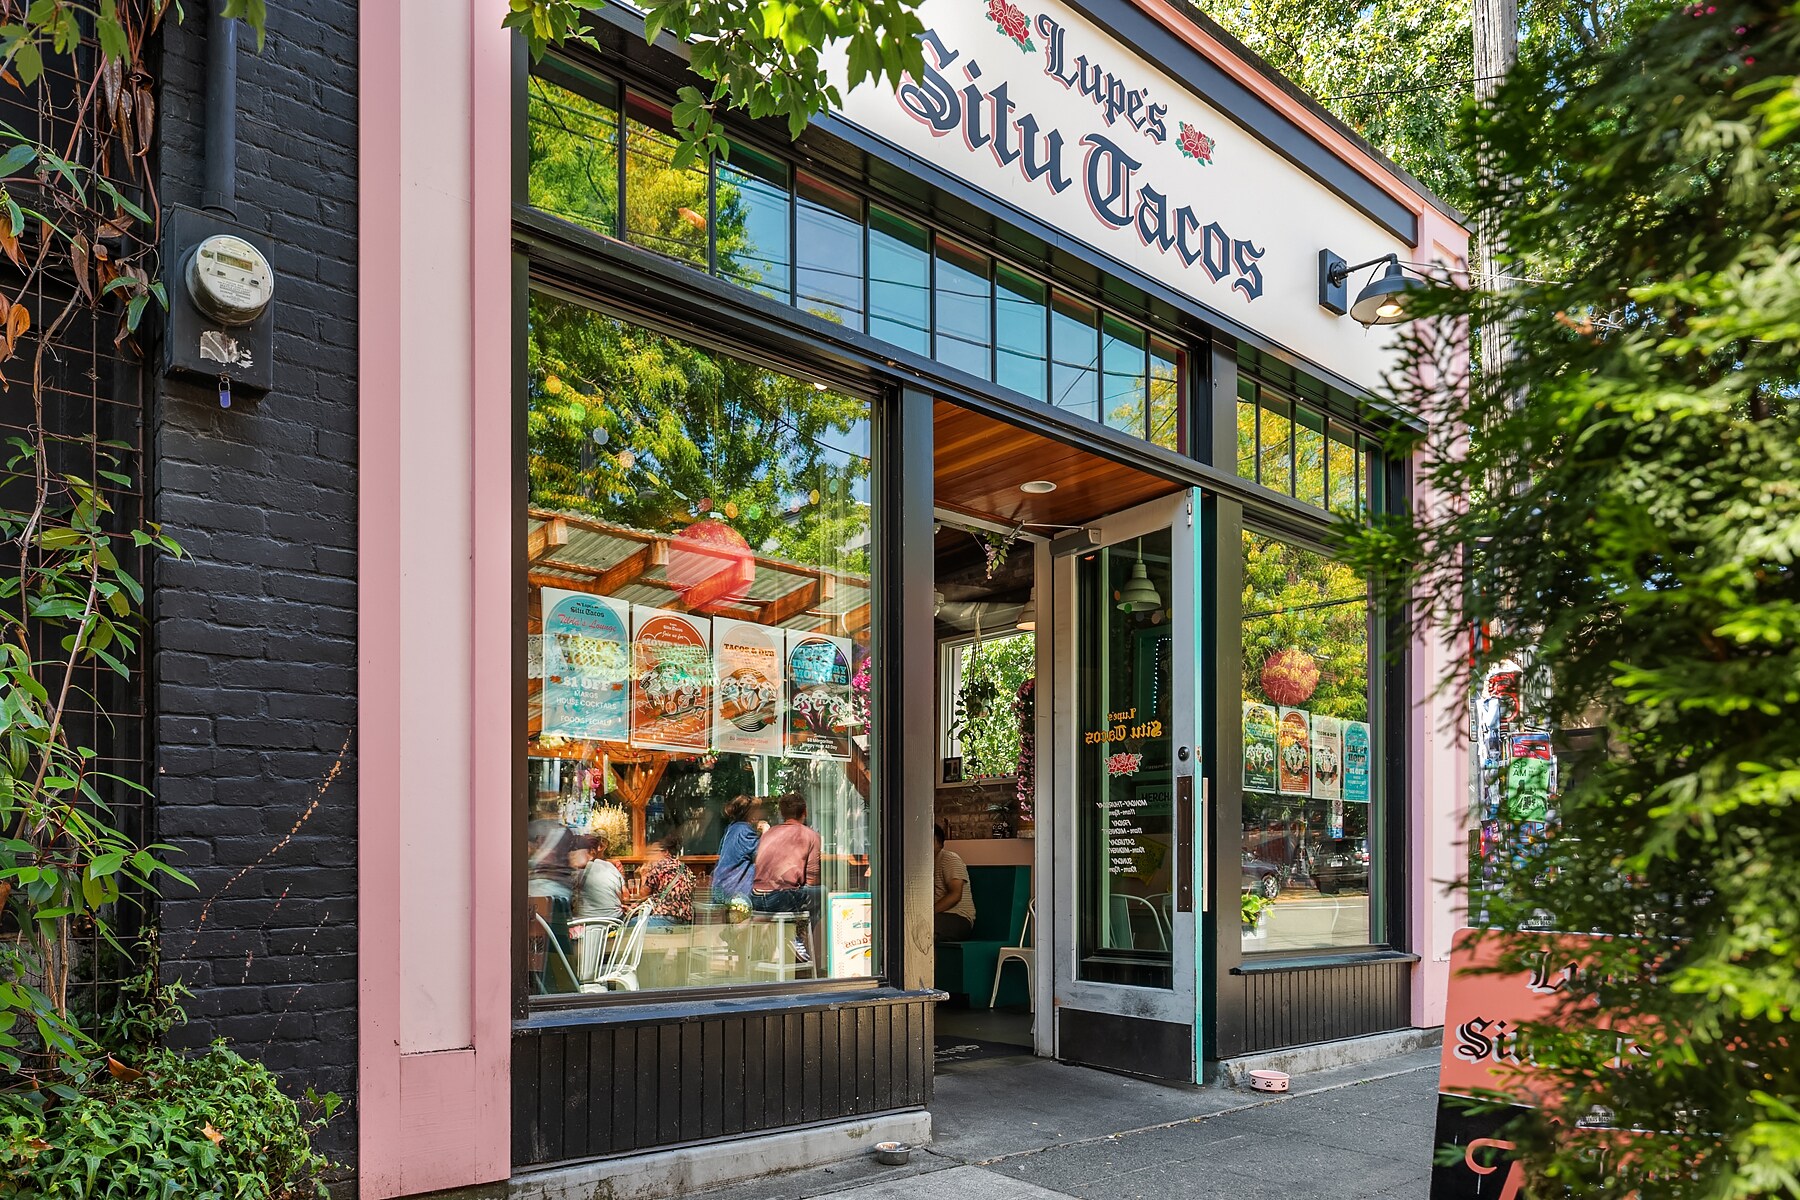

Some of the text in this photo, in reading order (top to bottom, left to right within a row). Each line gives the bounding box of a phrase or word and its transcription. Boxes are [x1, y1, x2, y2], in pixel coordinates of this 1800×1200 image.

[1032, 13, 1168, 144] Lupe's
[898, 28, 1266, 304] Situ Tacos
[585, 608, 605, 618] Tacos
[723, 643, 750, 653] TACOS
[563, 675, 611, 692] $1 OFF
[574, 689, 599, 699] MARGS
[556, 696, 579, 706] HOUSE
[560, 715, 580, 723] FOOD
